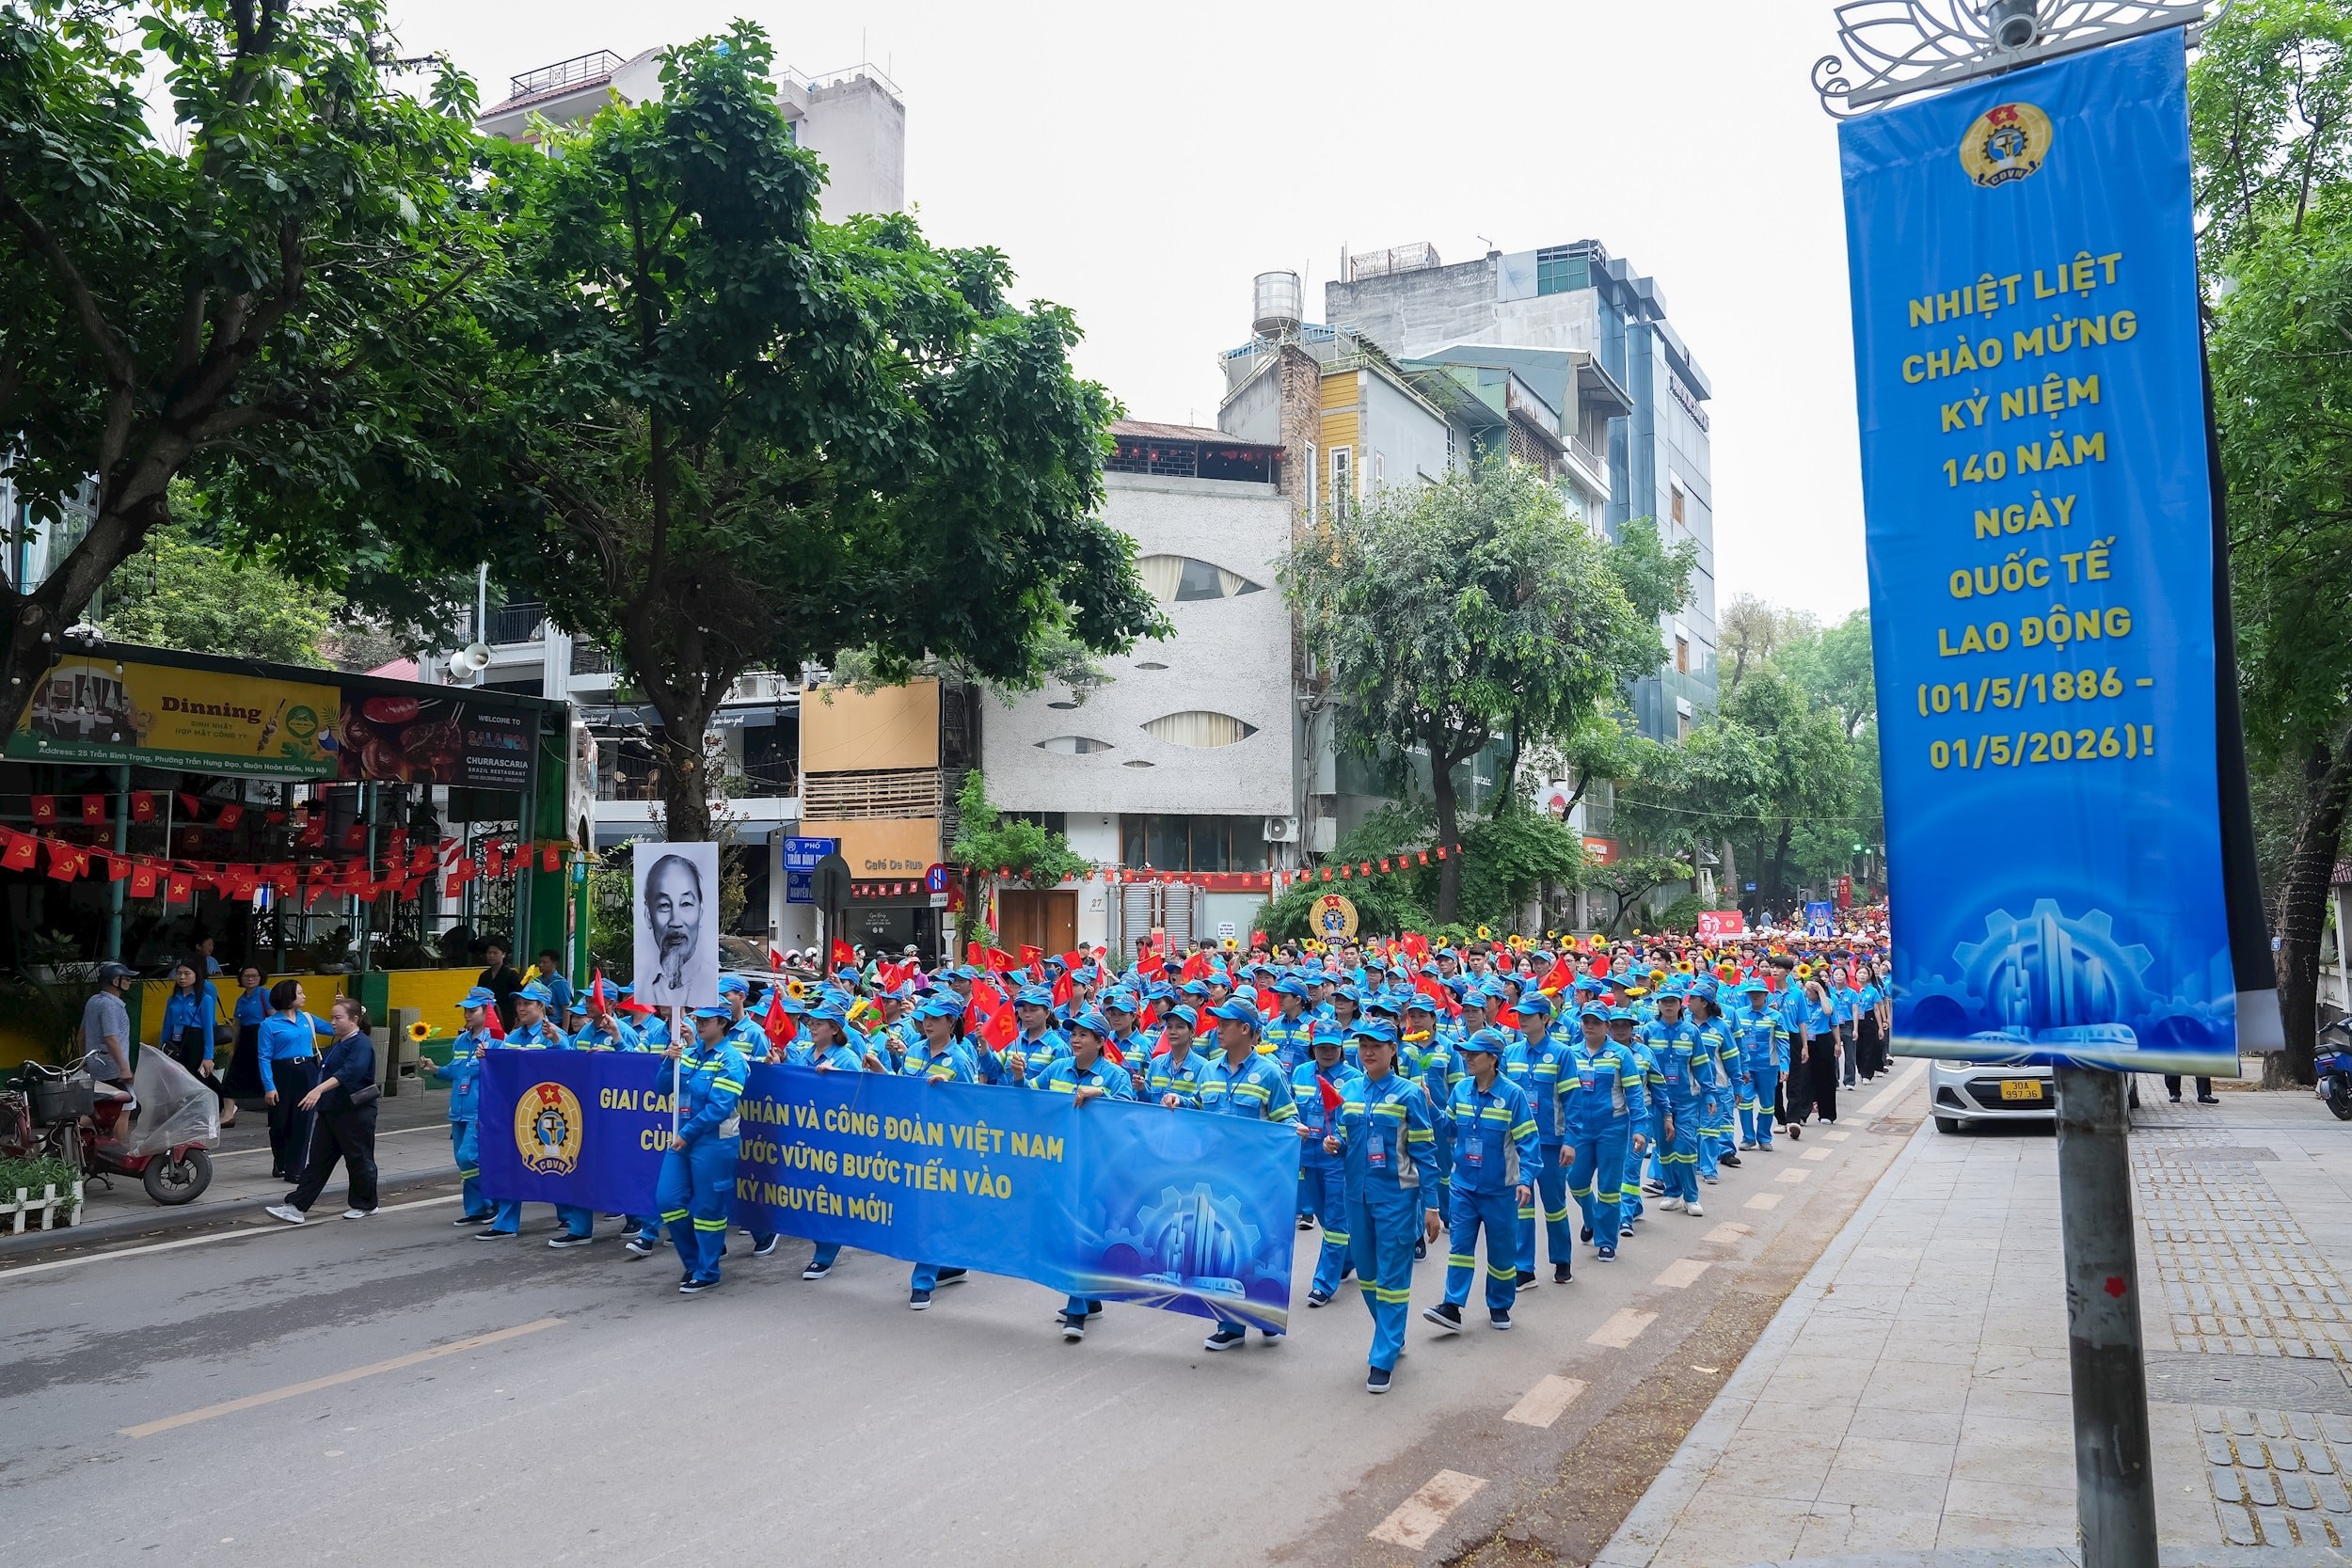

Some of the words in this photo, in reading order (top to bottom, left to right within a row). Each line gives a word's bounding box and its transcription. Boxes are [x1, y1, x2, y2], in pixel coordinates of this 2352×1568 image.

[1909, 273, 2022, 328] NHIỆT
[2034, 250, 2122, 299] LIỆT
[1902, 335, 2003, 384] CHÀO
[2013, 313, 2137, 360] MỪNG
[1941, 388, 1990, 433] KỶ
[2001, 372, 2100, 421] NIỆM
[1943, 451, 2007, 487] 140
[2016, 429, 2106, 474] NĂM
[1974, 490, 2076, 540] NGÀY
[1949, 547, 2051, 599] QUỐC
[2059, 535, 2116, 584] TẾ
[1938, 622, 2010, 657] LAO
[2020, 603, 2132, 652] ĐỘNG
[161, 696, 262, 724] Dinning
[1917, 666, 2123, 718] (01/5/1886
[478, 715, 511, 724] WELCOME
[39, 747, 75, 756] Address:
[90, 750, 107, 758] Trần
[110, 752, 127, 760] Bình
[155, 755, 183, 766] Phường
[185, 756, 201, 765] Trần
[203, 759, 222, 768] Hưng
[316, 767, 327, 775] Nội
[466, 756, 529, 768] CHURRASCARIA
[1930, 722, 2153, 769] 01/5/2026)!
[787, 851, 802, 865] TRẦN
[804, 841, 821, 849] PHỐ
[865, 858, 887, 870] Café
[890, 859, 902, 870] De
[905, 859, 924, 870] Rue
[1091, 899, 1103, 908] 27
[2006, 1090, 2038, 1099] 997.36
[2012, 1082, 2029, 1090] 30A
[599, 1087, 638, 1111] GIAI
[737, 1095, 789, 1126] NHÂN
[793, 1100, 820, 1131] VÀ
[824, 1103, 879, 1138] CÔNG
[884, 1113, 944, 1148] ĐOÀN
[949, 1120, 1005, 1158] VIỆT
[1011, 1132, 1064, 1164] NAM
[739, 1134, 778, 1165] ƯỚC
[781, 1141, 837, 1174] VỮNG
[843, 1150, 900, 1183] BƯỚC
[904, 1158, 957, 1193] TIẾN
[963, 1165, 1012, 1199] VÀO
[737, 1173, 759, 1202] KỶ
[764, 1183, 843, 1218] NGUYÊN
[848, 1193, 894, 1227] MỚI!
